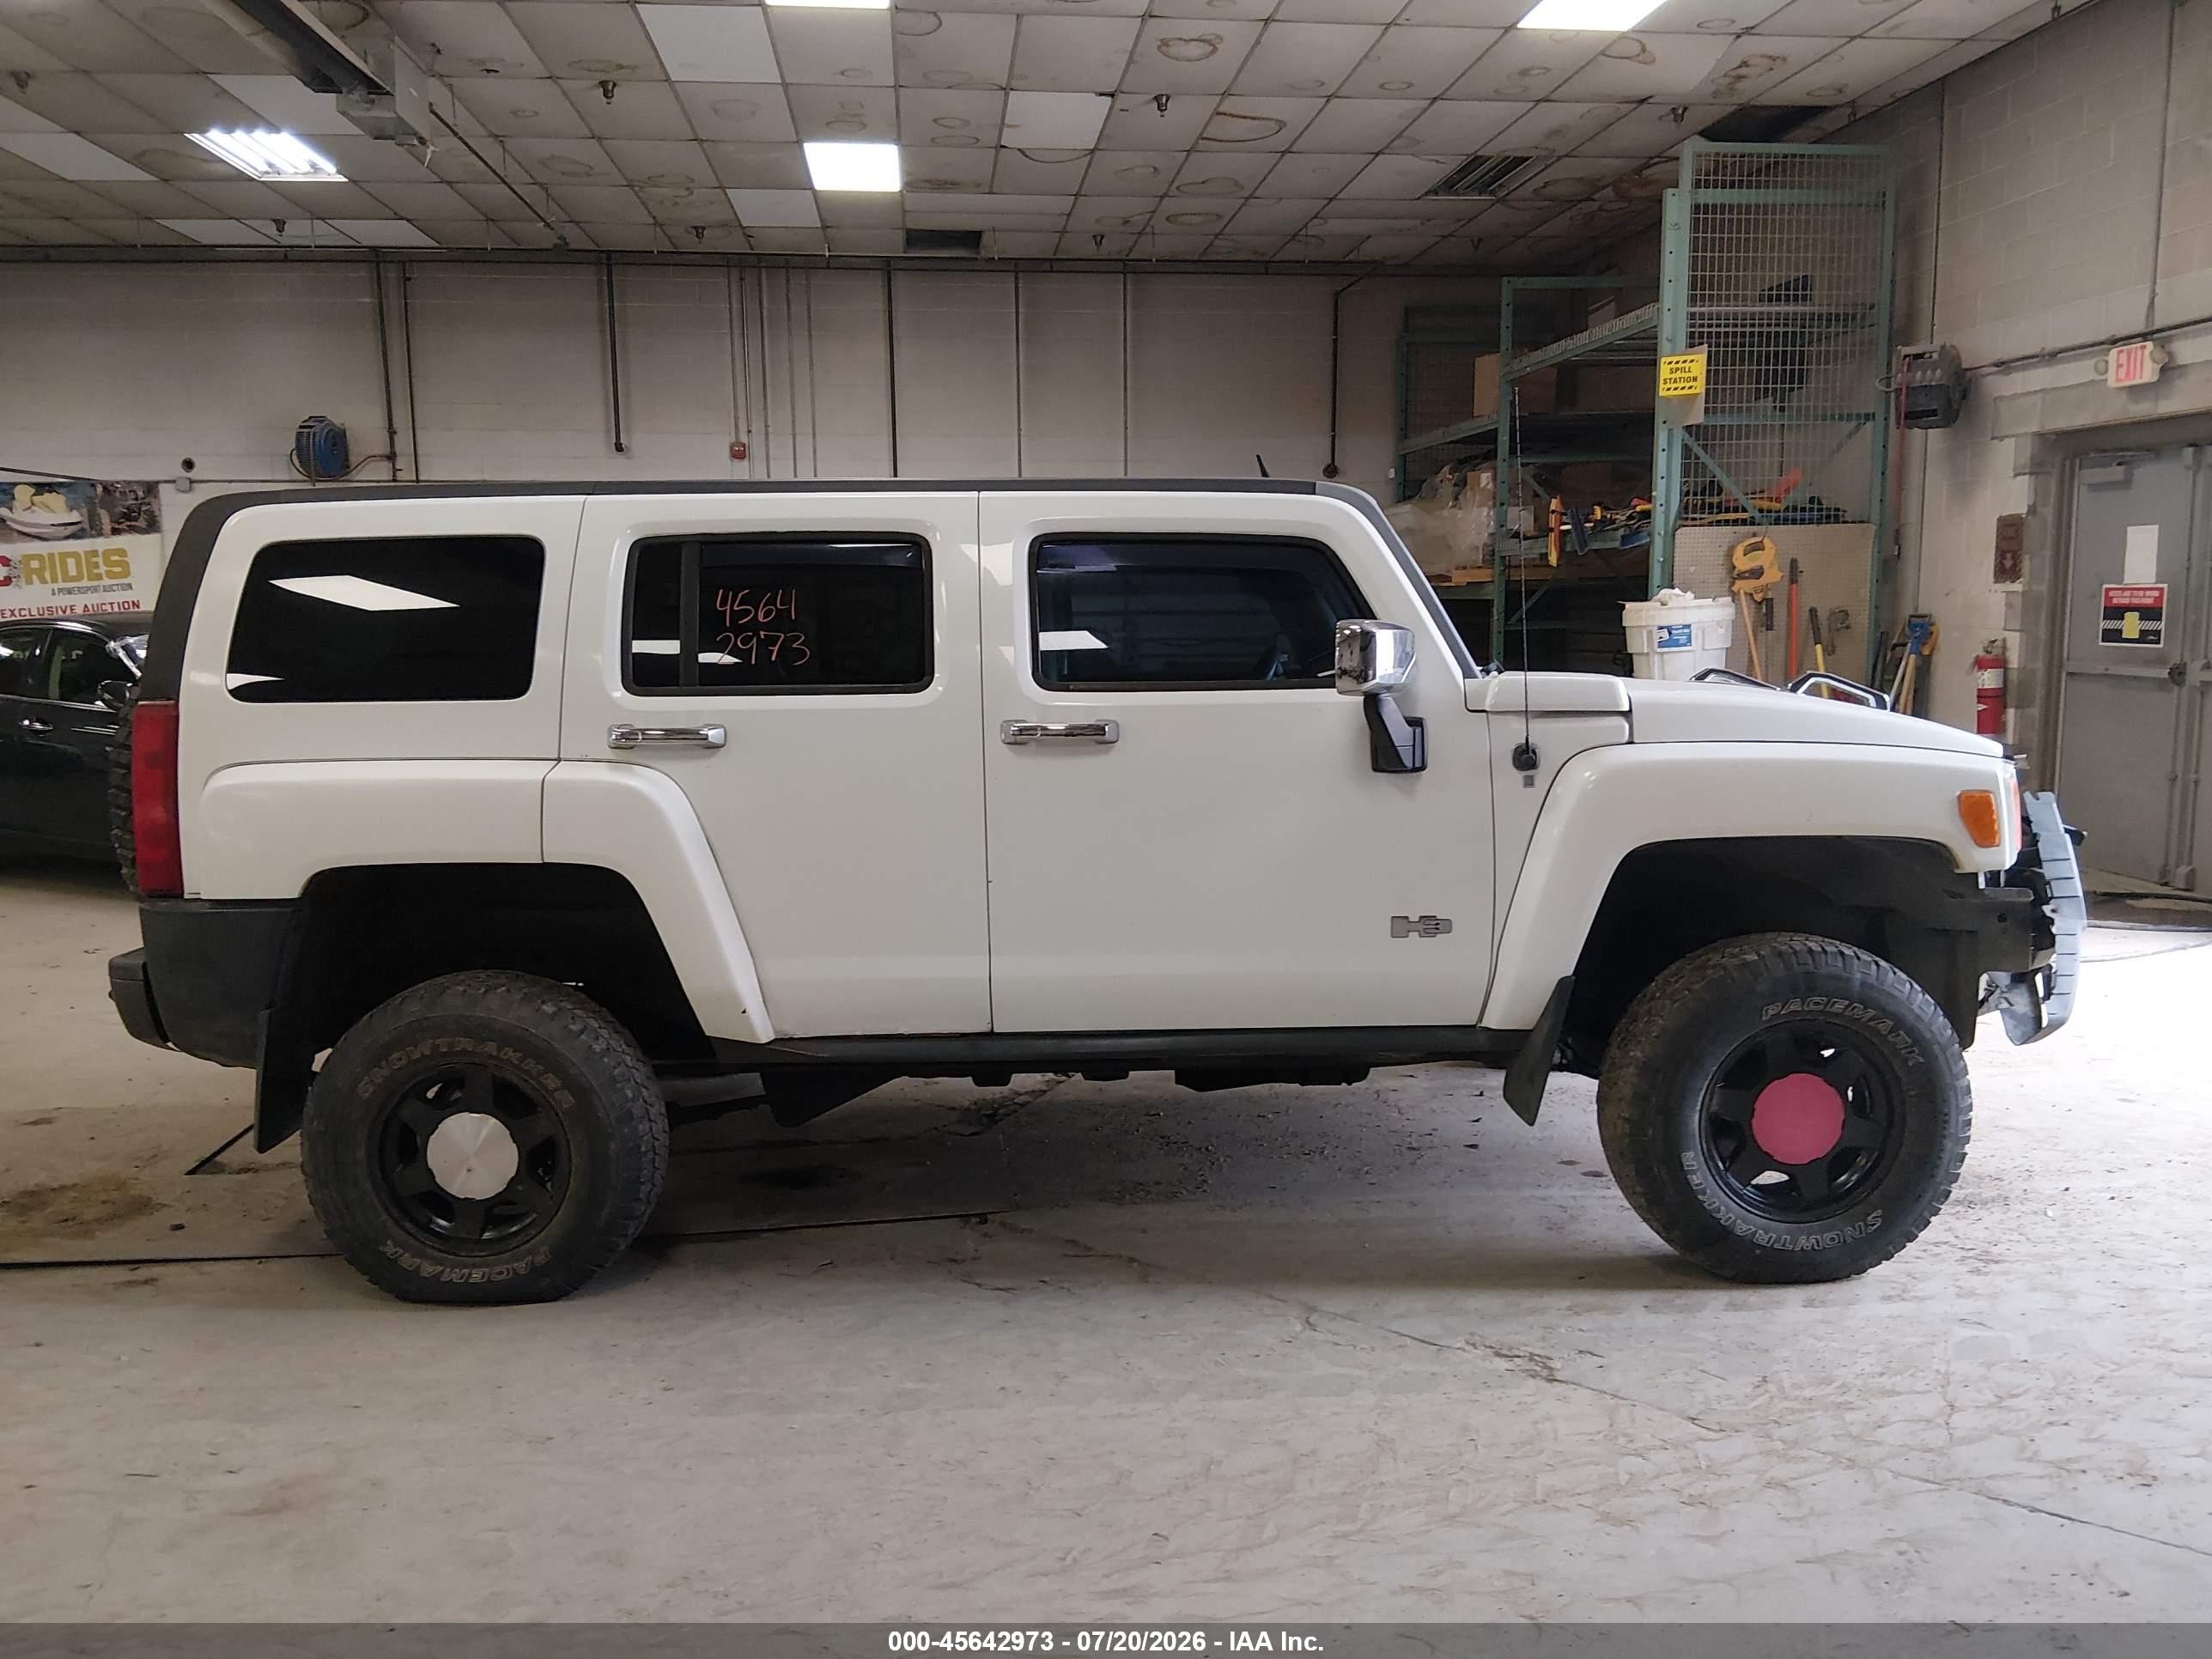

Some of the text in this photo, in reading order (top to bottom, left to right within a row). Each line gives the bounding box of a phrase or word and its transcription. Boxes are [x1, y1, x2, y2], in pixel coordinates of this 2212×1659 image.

[1662, 376, 1698, 386] STATION
[1668, 366, 1692, 375] SPILL
[2116, 344, 2147, 383] EXIT
[21, 548, 131, 585] RIDES
[52, 582, 133, 596] A POWERSPORT AUCTION
[715, 588, 797, 627] 4564
[1, 600, 140, 618] EXCLUSIVE AUCTION
[716, 632, 811, 665] 2973
[1762, 996, 1926, 1066] PACEMARK
[356, 1037, 576, 1109] SNOWTRAKKER
[1680, 1151, 1884, 1251] SNOWTRAKKER
[379, 1239, 550, 1283] PACEMARK
